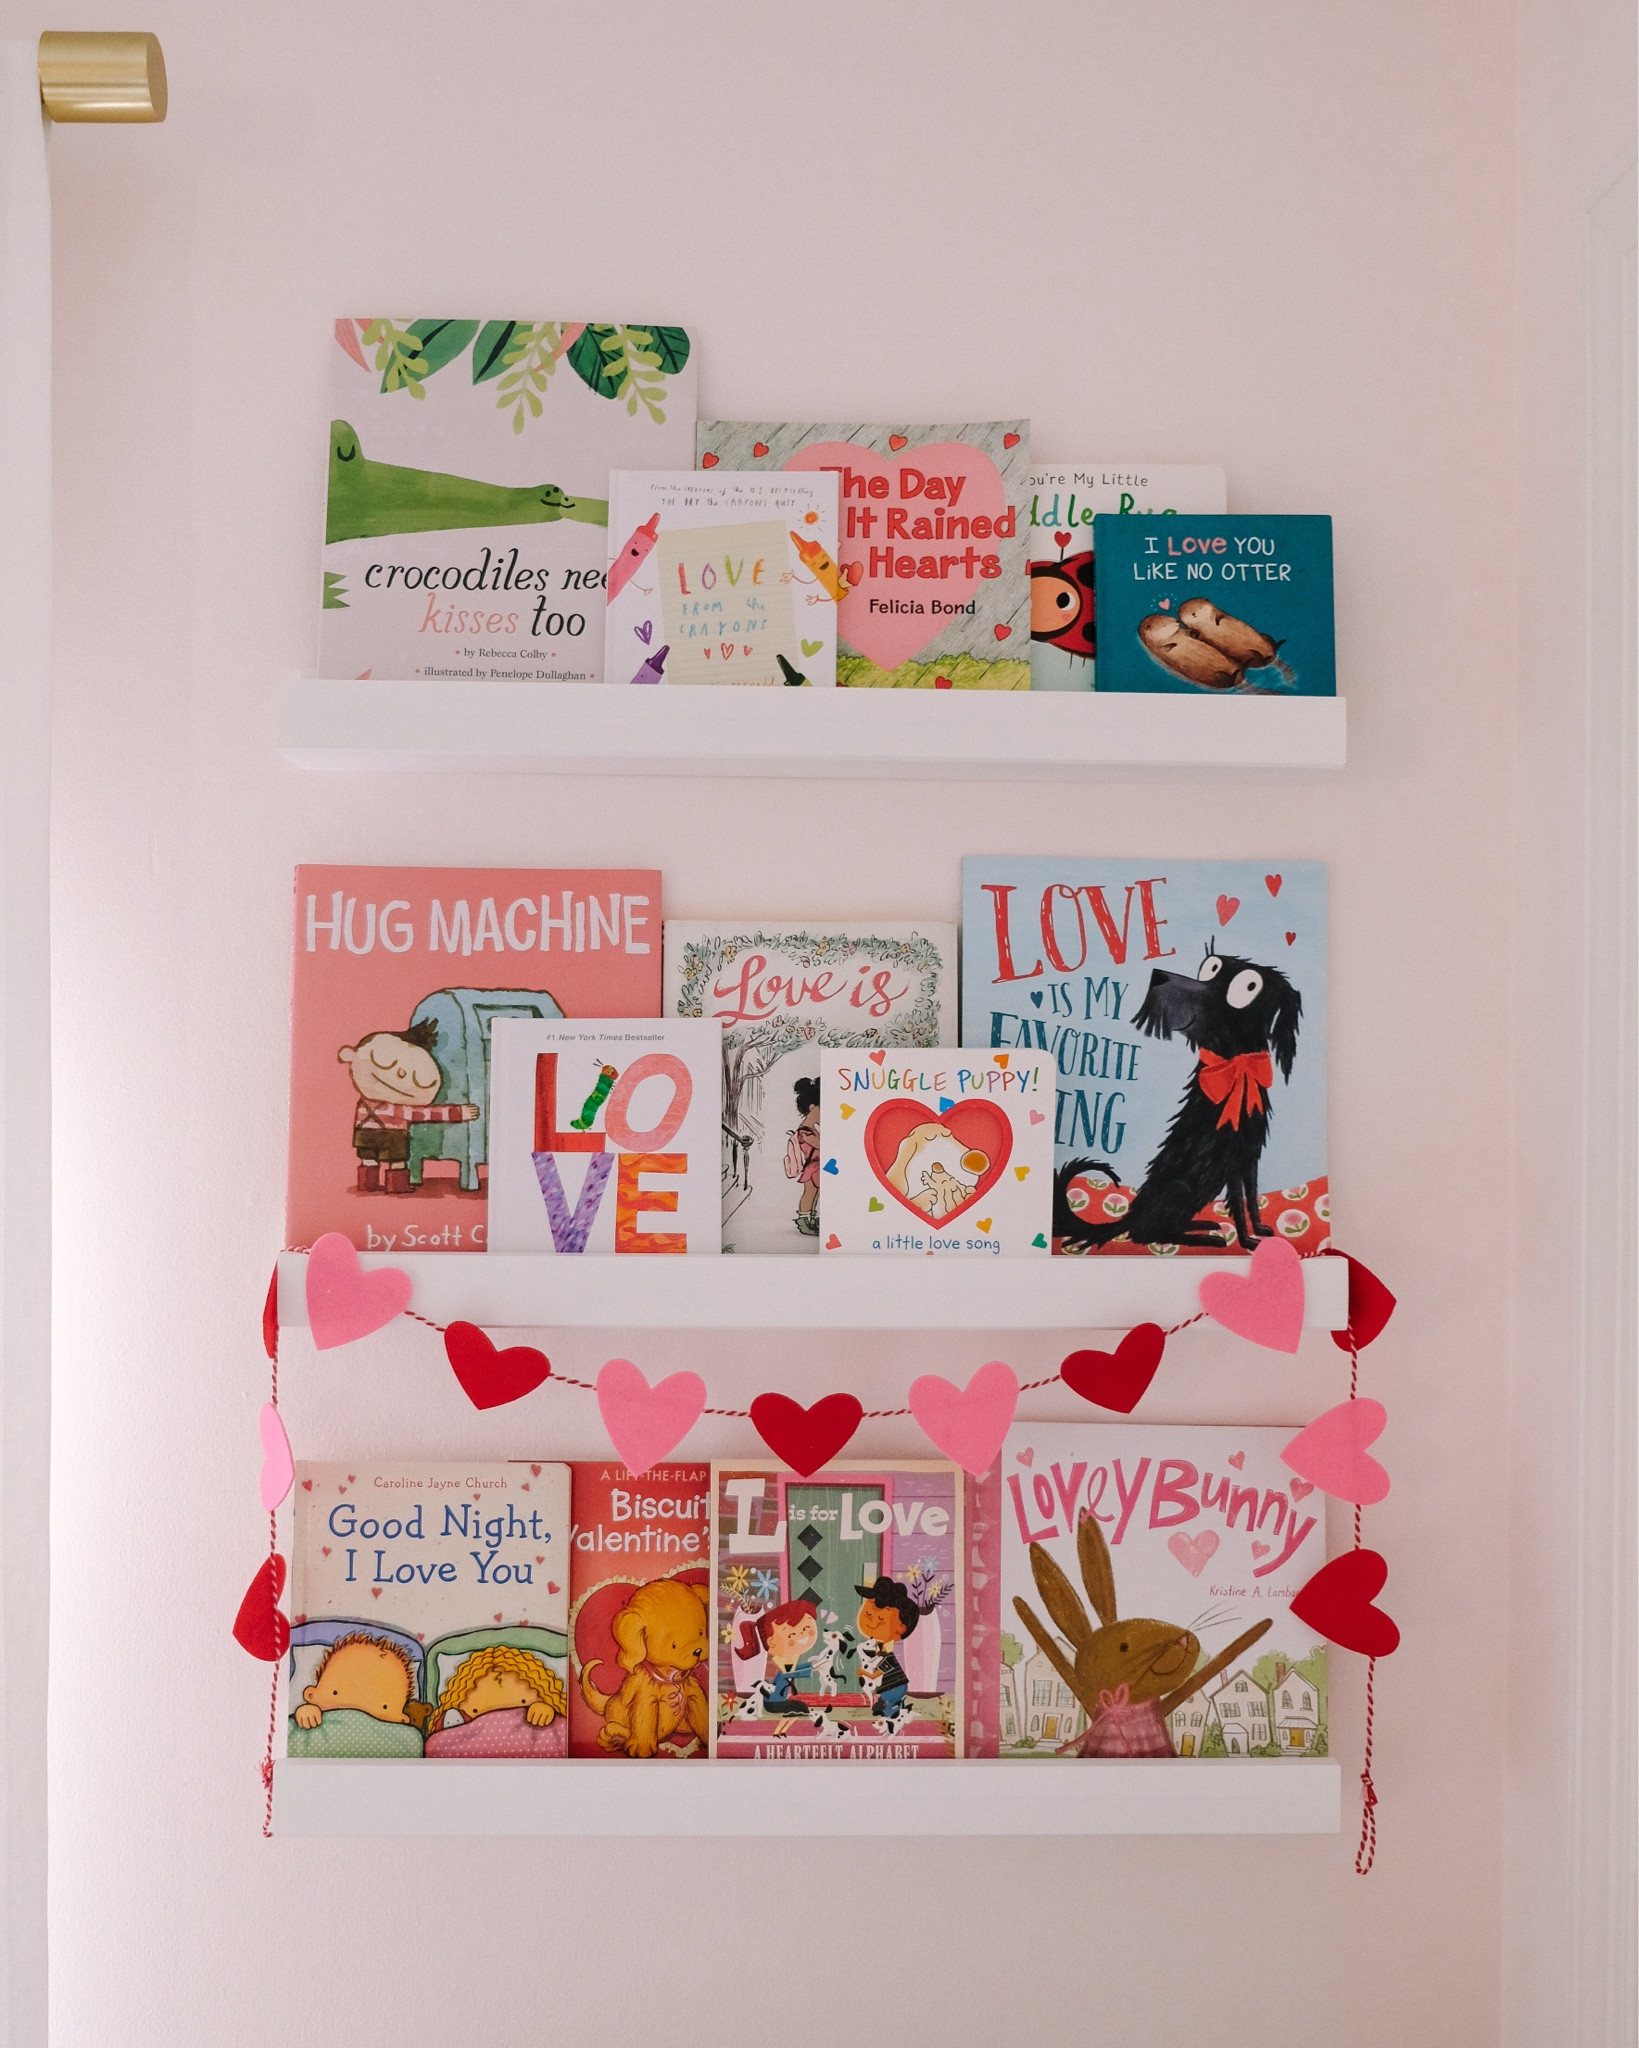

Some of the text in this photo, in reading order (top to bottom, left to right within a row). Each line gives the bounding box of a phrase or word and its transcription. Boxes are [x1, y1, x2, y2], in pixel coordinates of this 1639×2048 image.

[820, 466, 967, 507] he Day
[1074, 473, 1094, 488] My
[1102, 473, 1148, 487] Little
[847, 505, 1016, 540] It Rained
[1145, 537, 1159, 554] I
[1234, 537, 1275, 556] YOU
[365, 547, 550, 591] crocodiles
[678, 555, 766, 595] LOVE
[869, 547, 1002, 579] Hearts
[1187, 562, 1213, 581] NO
[1221, 562, 1292, 581] OTTER
[418, 592, 586, 637] kisses too
[682, 601, 722, 616] FROM
[869, 599, 976, 615] Felicia Bond
[679, 619, 768, 638] CRAYONS
[464, 648, 548, 660] by Rebecca Colby
[424, 667, 586, 681] illustrated by Penelope Dullaghan
[307, 891, 651, 957] HUG MACHINE
[981, 878, 1177, 984] LOVE
[712, 955, 909, 1028] Love is
[1047, 976, 1129, 1020] IS MY
[838, 1067, 1040, 1093] SNUGGLE PUPPY!
[366, 1224, 397, 1251] by
[401, 1225, 462, 1247] Scott
[872, 1234, 1001, 1255] a little love song
[374, 1477, 507, 1490] Caroline Jayne Church
[600, 1469, 611, 1480] A
[611, 1488, 711, 1522] Biscuit
[725, 1478, 950, 1554] L is for Love
[1149, 1459, 1318, 1578] Bunny
[329, 1503, 551, 1548] Good Night,
[569, 1523, 711, 1553] alentine'
[345, 1548, 534, 1584] I Love You
[1209, 1584, 1246, 1597] Kristine
